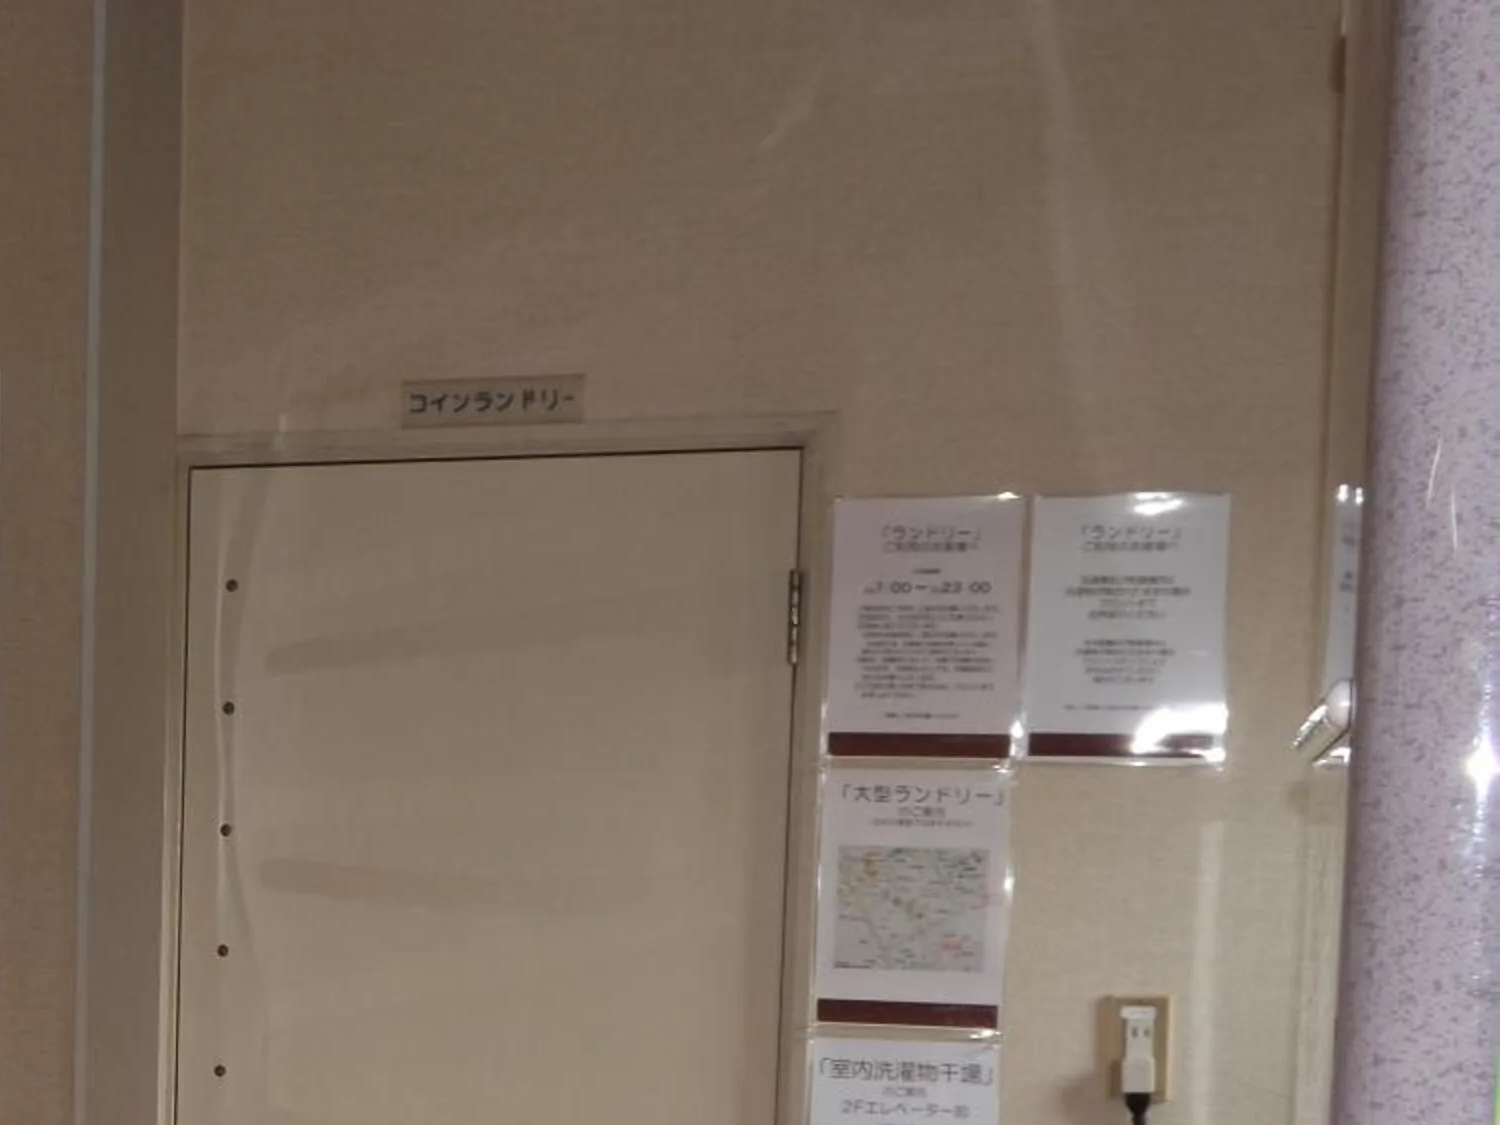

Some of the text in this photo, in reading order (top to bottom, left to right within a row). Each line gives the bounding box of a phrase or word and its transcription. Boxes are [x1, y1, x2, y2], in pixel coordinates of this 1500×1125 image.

[408, 388, 576, 414] コインランドリー
[842, 783, 1005, 806] 「大型ランドリー」
